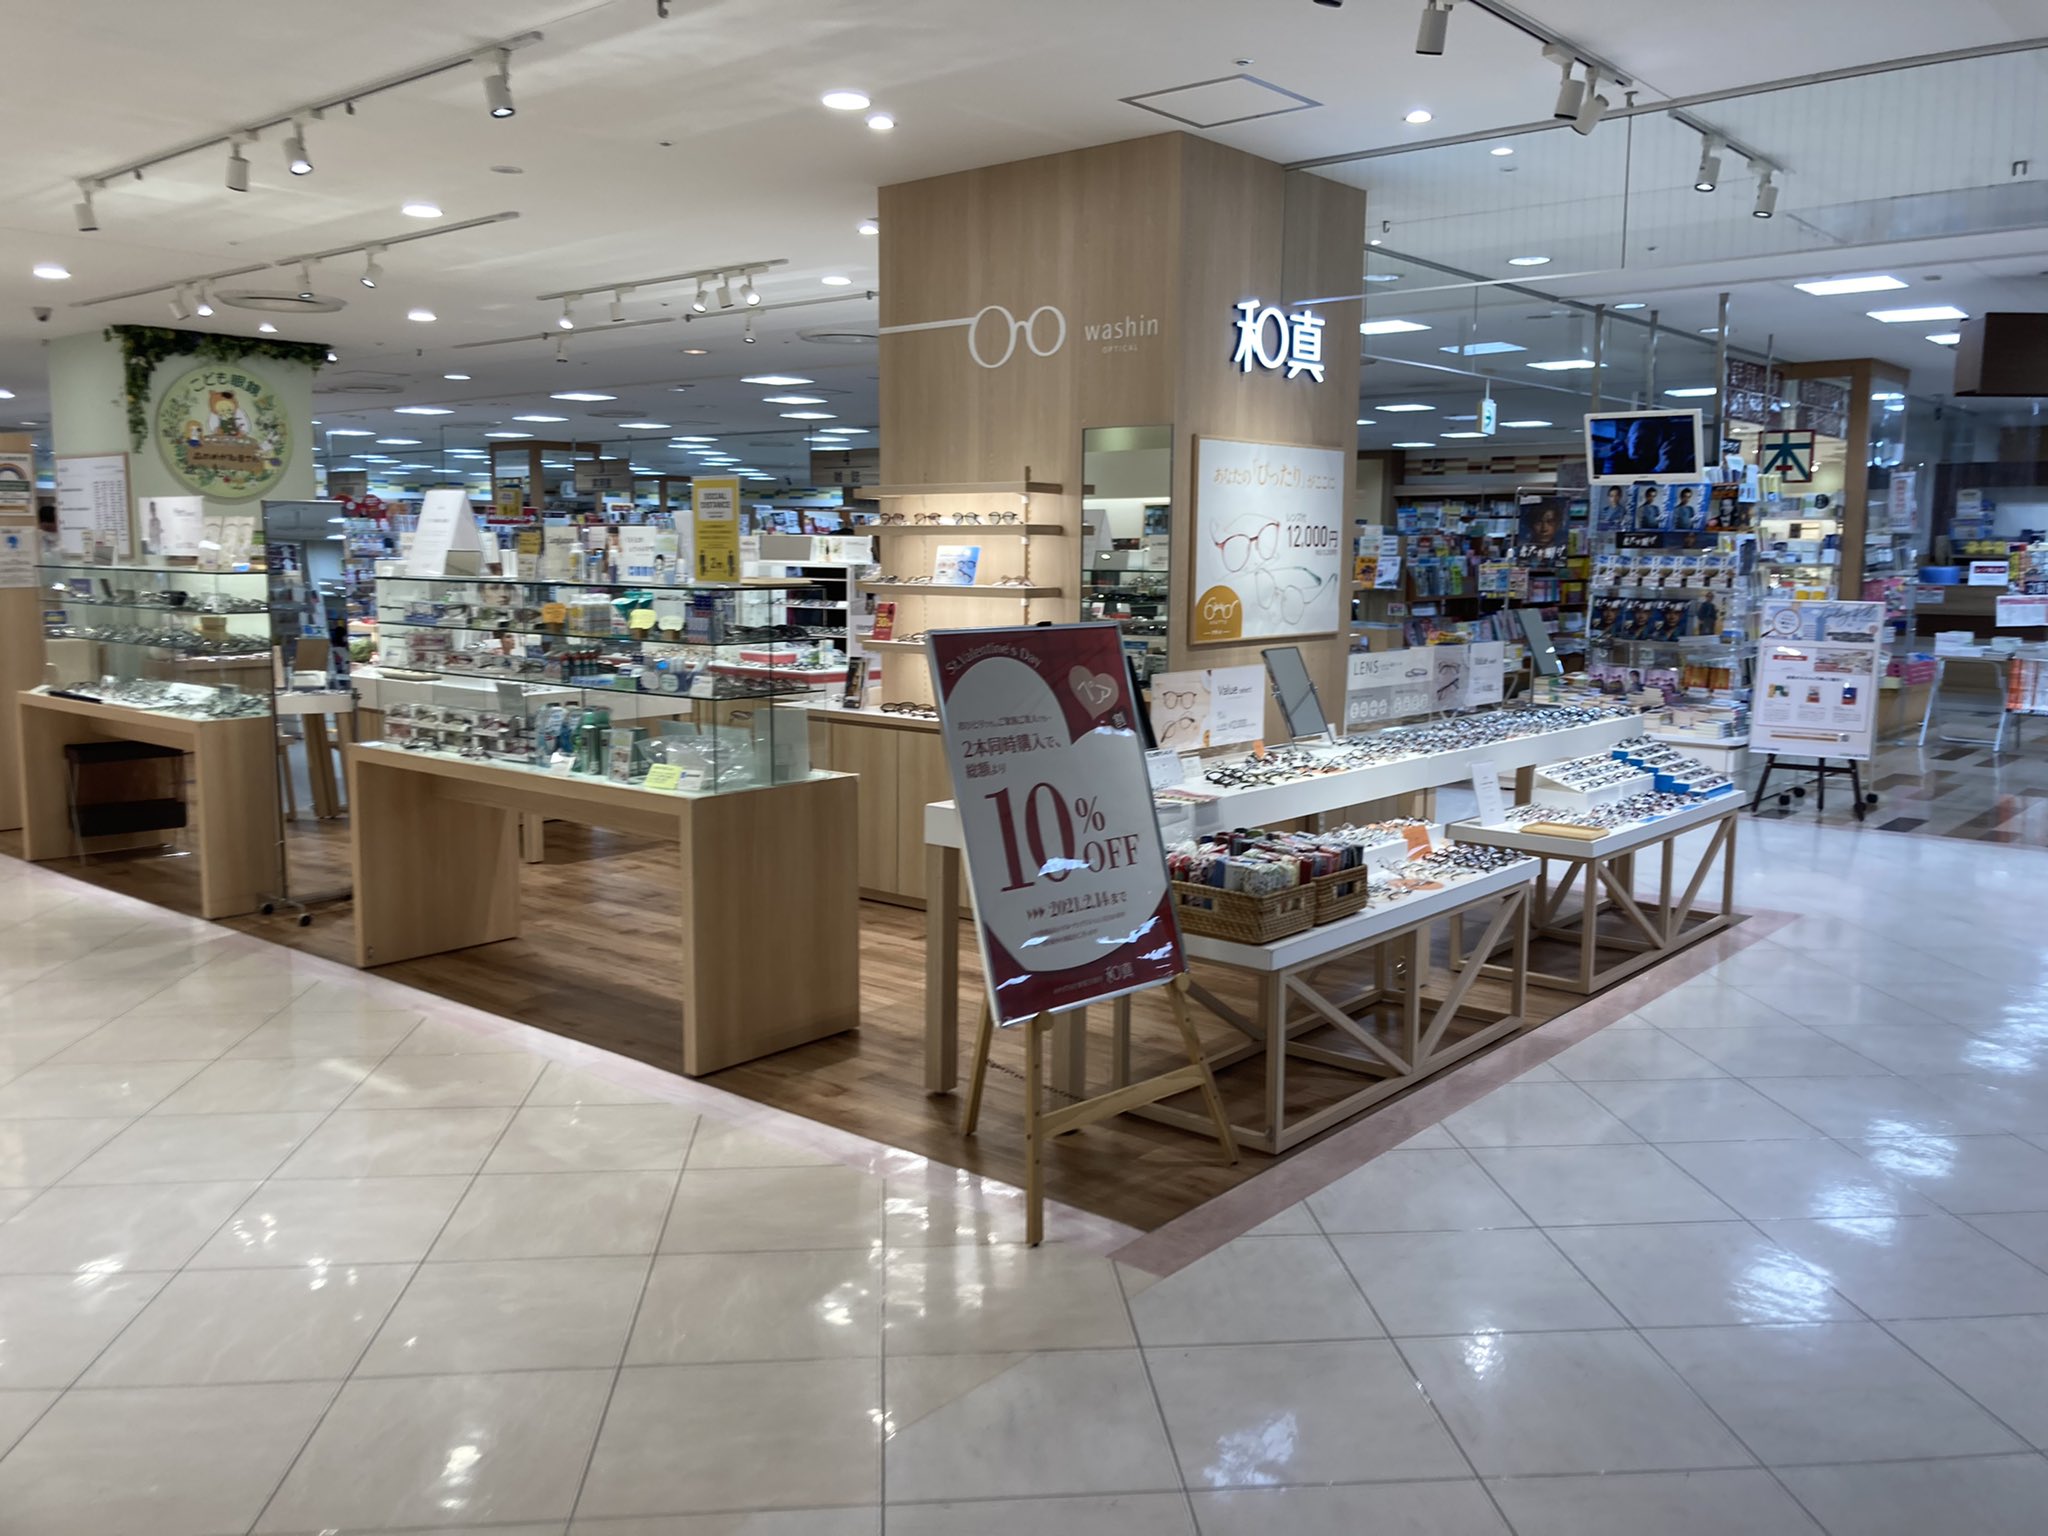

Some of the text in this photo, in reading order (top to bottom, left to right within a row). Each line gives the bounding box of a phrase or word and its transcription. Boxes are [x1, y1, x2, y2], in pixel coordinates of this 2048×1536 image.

[1085, 314, 1159, 342] washin
[1234, 299, 1326, 383] 和真
[1102, 345, 1139, 354] OPTICAL
[703, 492, 727, 500] SOCIAL
[700, 501, 730, 509] DISTANCE
[1019, 647, 1043, 670] Day
[1353, 660, 1380, 676] LENS
[1217, 684, 1239, 697] Value
[1083, 833, 1140, 874] OFF
